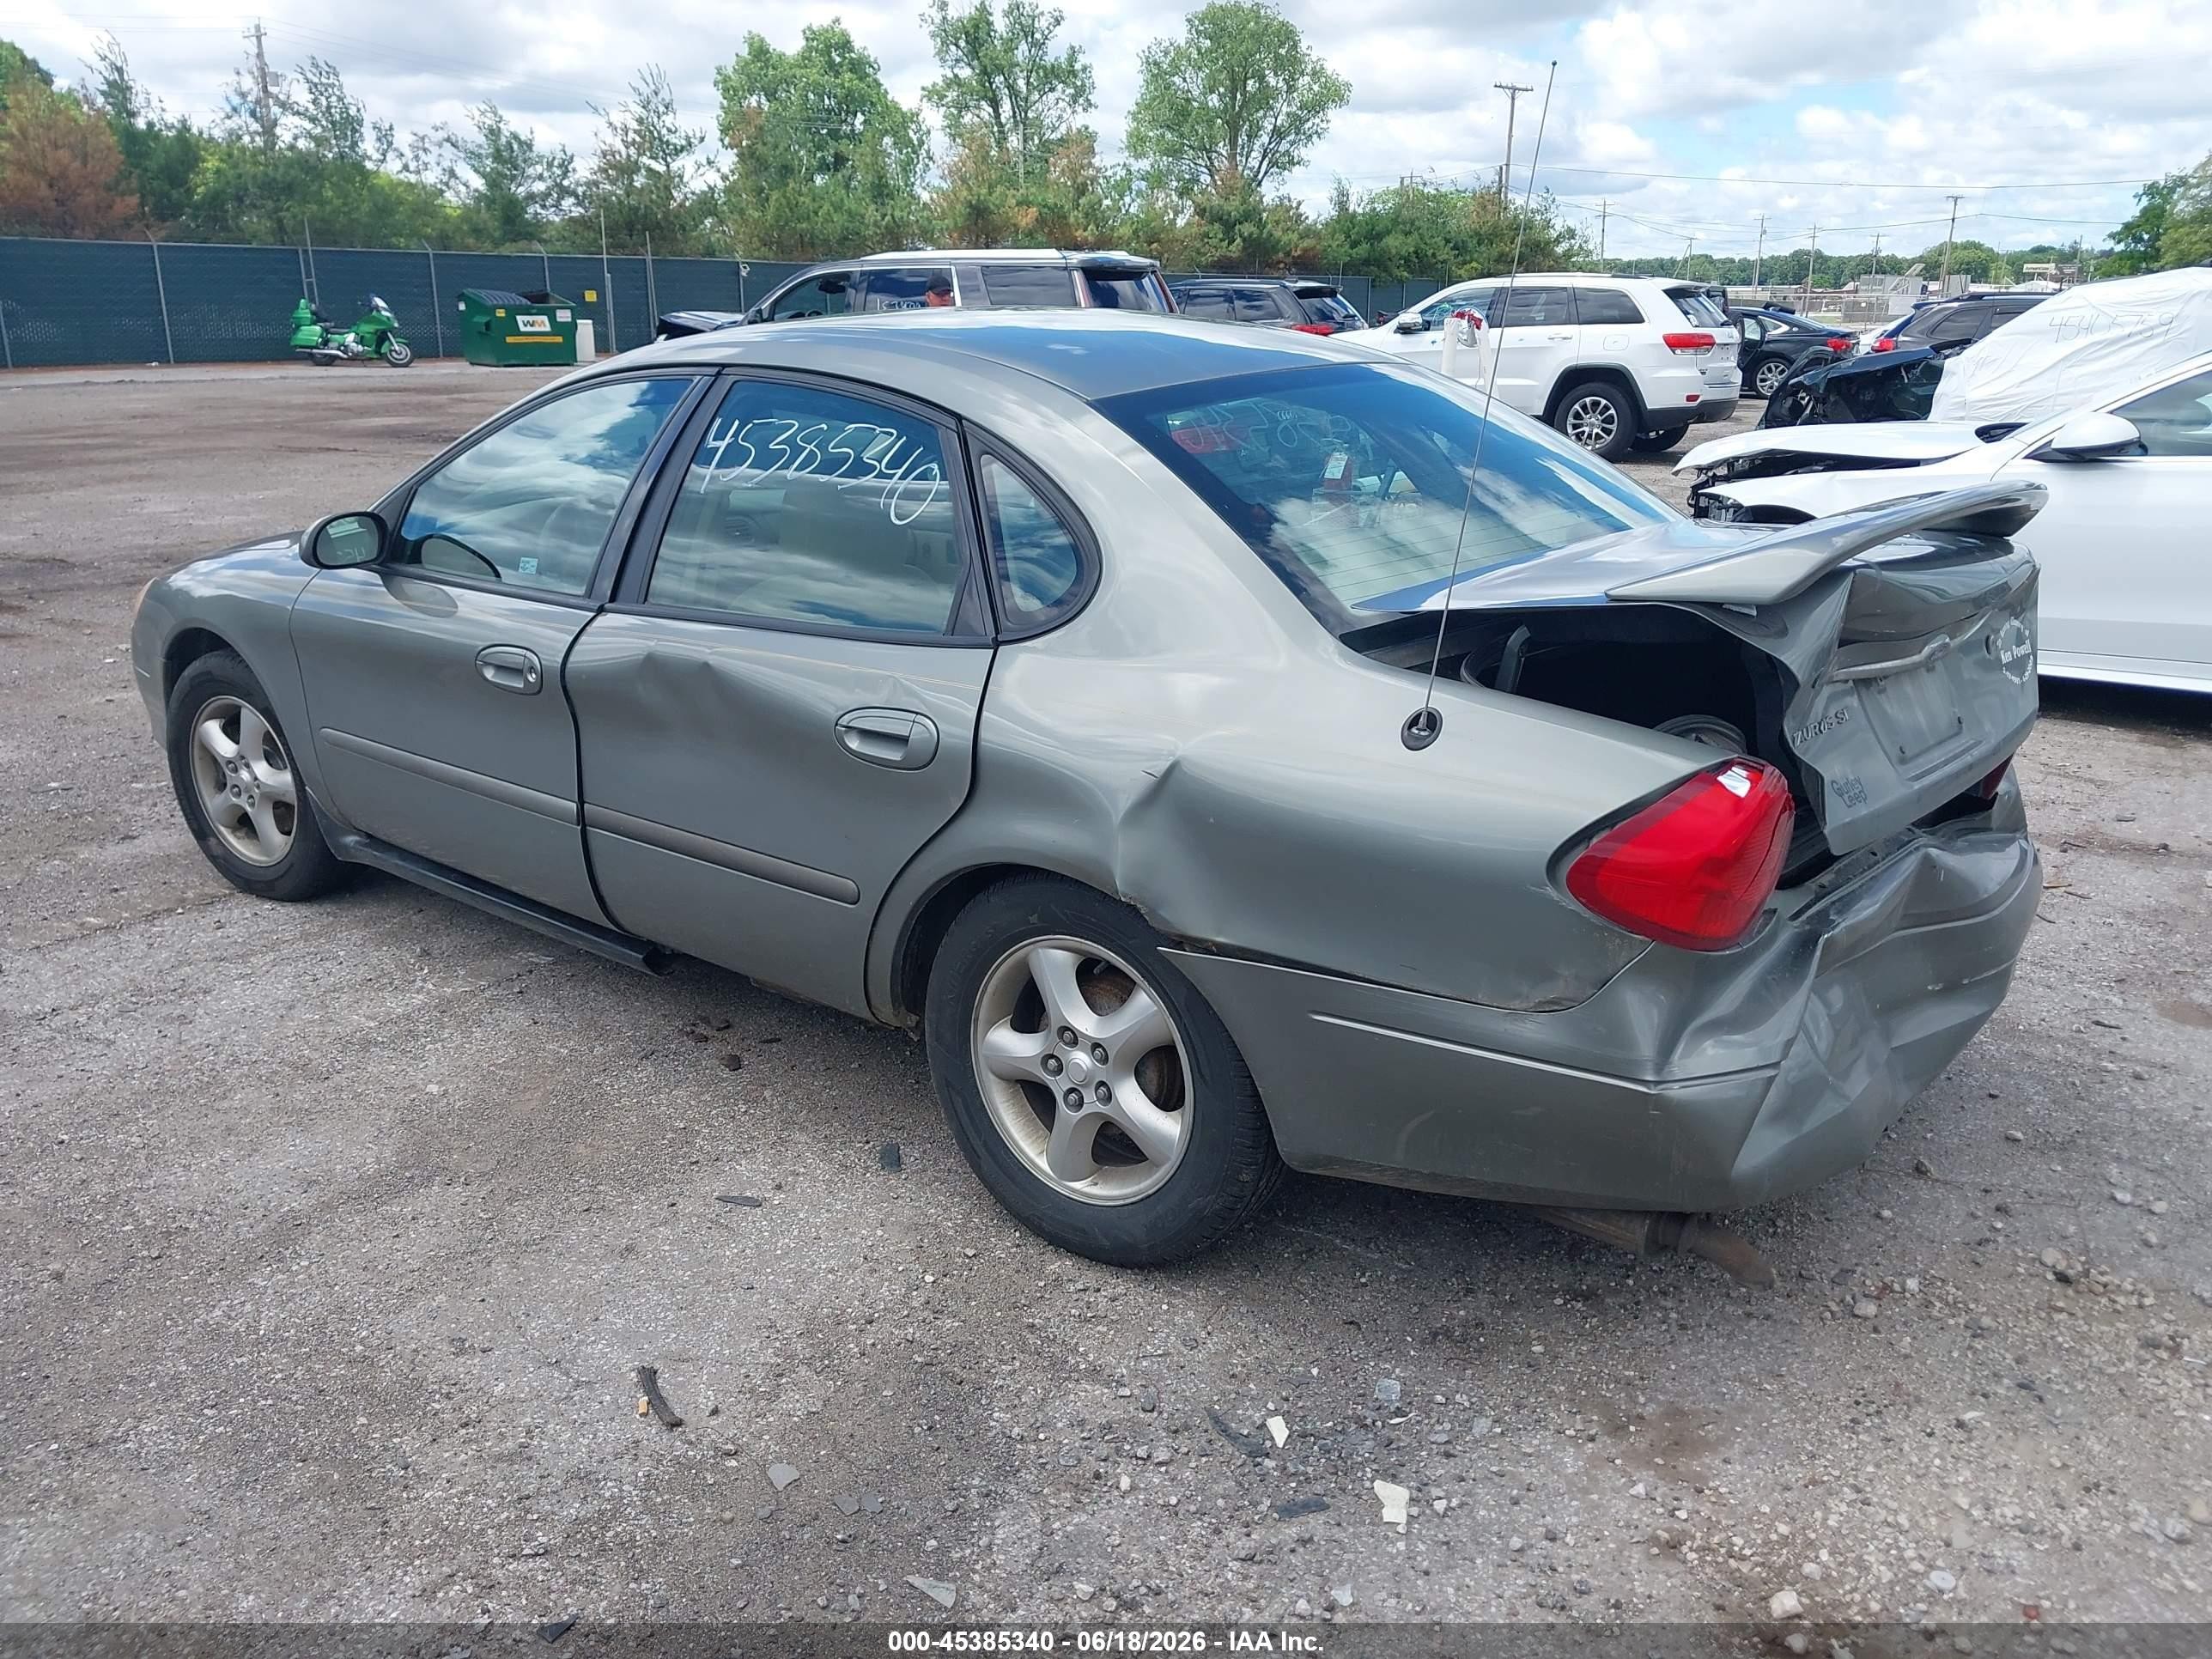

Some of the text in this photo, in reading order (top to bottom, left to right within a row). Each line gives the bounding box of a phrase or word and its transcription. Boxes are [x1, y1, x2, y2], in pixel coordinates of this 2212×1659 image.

[521, 319, 546, 328] WM
[700, 416, 940, 526] 45385340
[2000, 639, 2033, 665] Ken Powell
